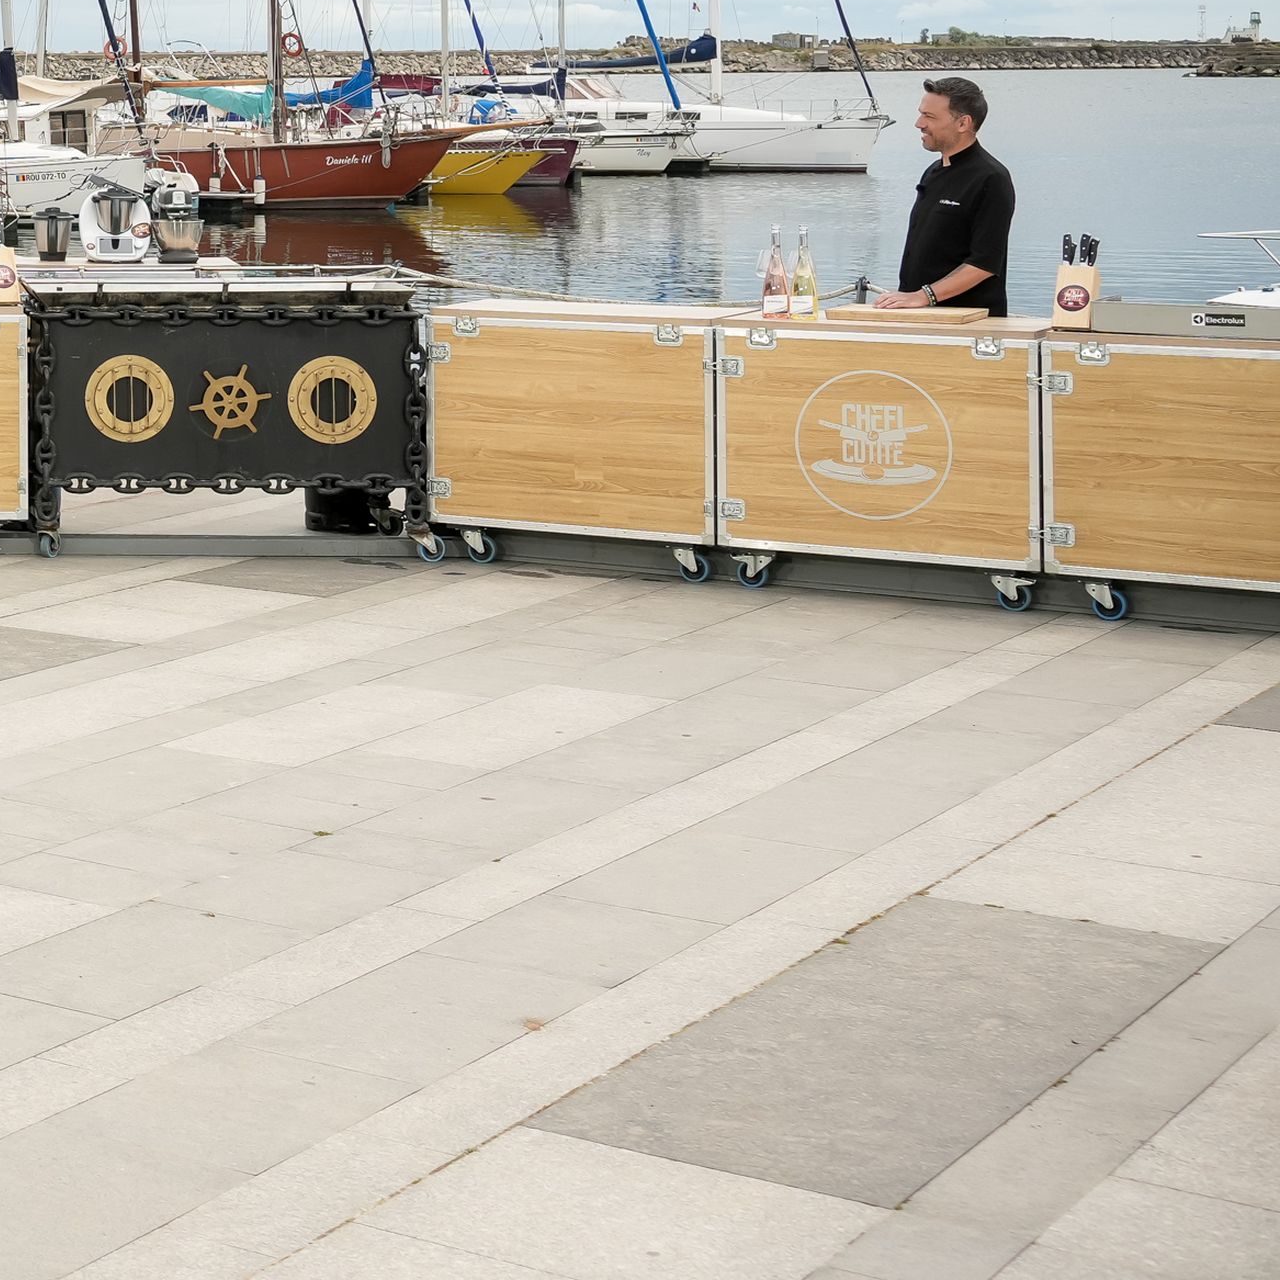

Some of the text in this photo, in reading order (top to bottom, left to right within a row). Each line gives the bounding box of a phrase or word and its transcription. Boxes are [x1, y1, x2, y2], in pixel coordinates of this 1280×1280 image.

[325, 154, 359, 166] Daniela
[25, 172, 67, 182] ROU 072-TO
[1205, 316, 1245, 325] Electrolux
[842, 404, 905, 433] CHEFI
